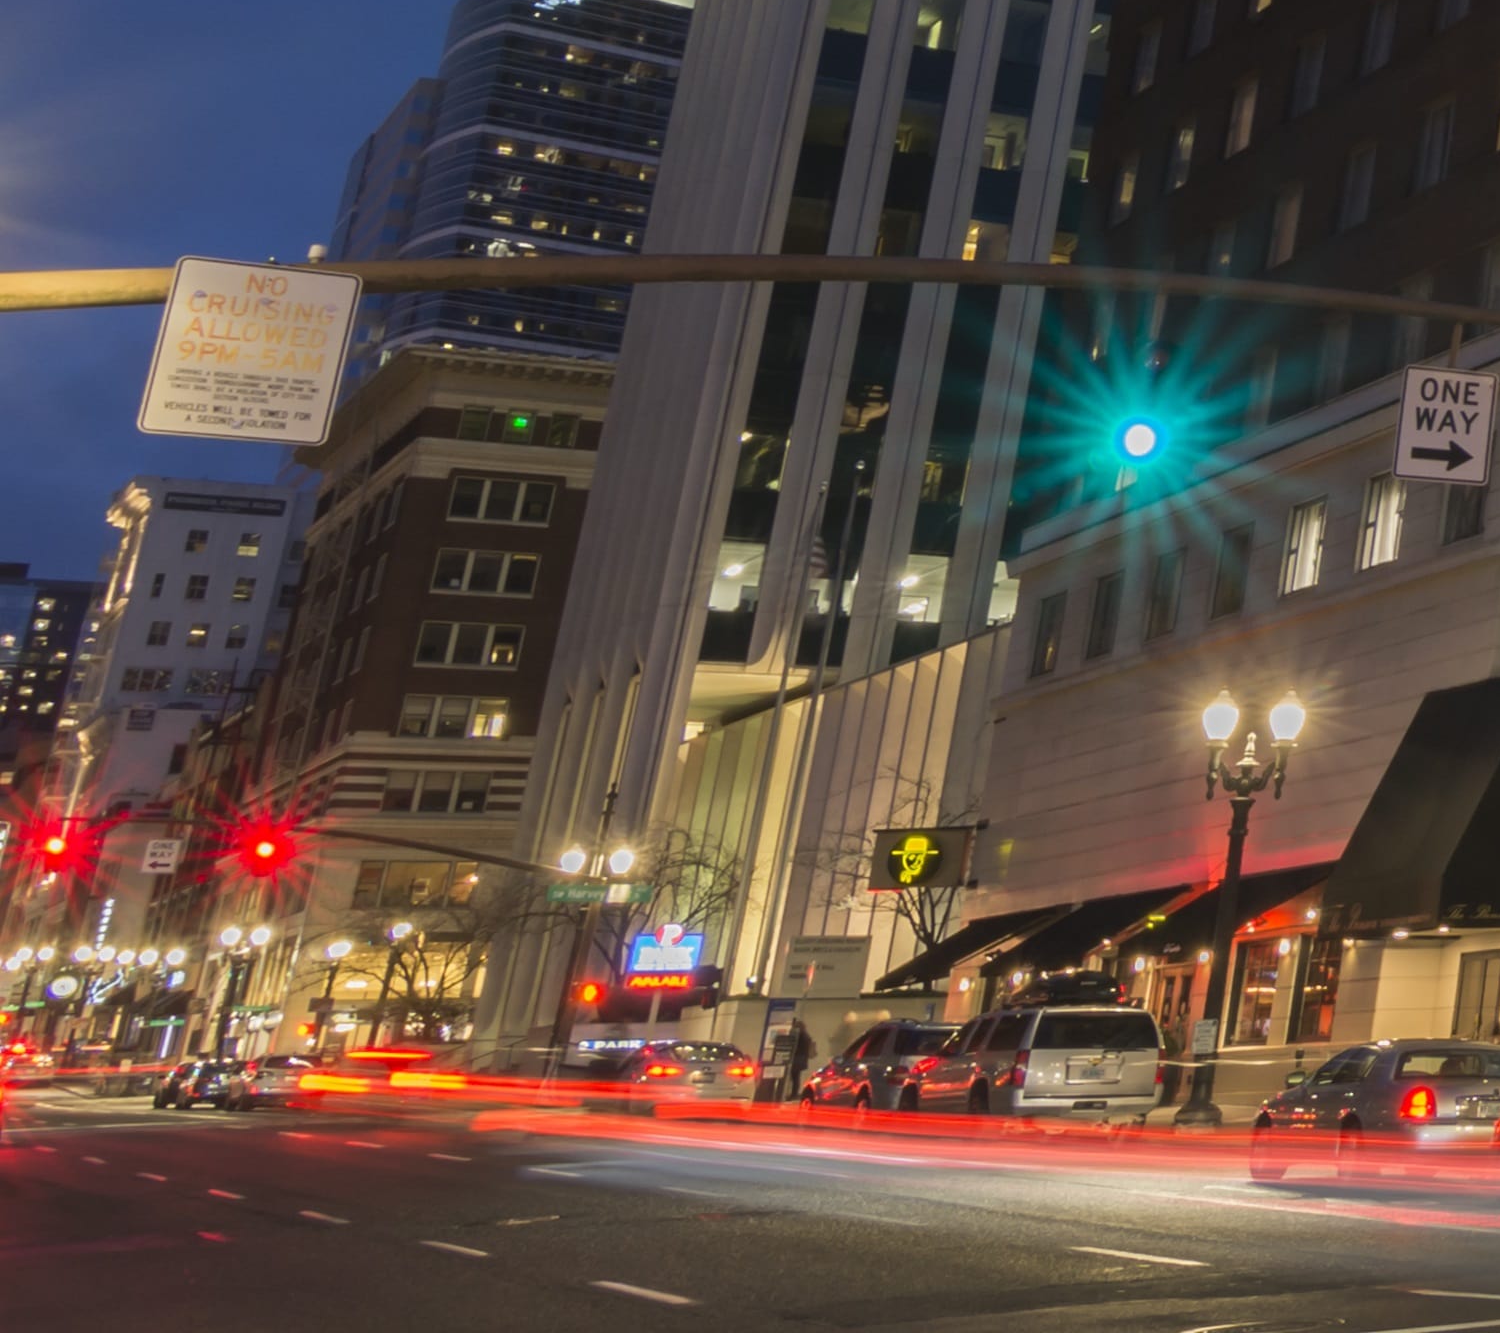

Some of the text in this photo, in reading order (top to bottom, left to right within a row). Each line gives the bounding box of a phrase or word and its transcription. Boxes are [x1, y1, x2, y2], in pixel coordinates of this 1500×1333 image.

[246, 273, 289, 297] NO
[187, 292, 337, 326] CRUISING
[184, 316, 329, 349] ALLOWED
[1420, 377, 1480, 406] ONE
[164, 401, 312, 422] VEHICLES WILL BE TOWED FOR
[184, 414, 192, 422] A
[1416, 406, 1479, 435] WAY
